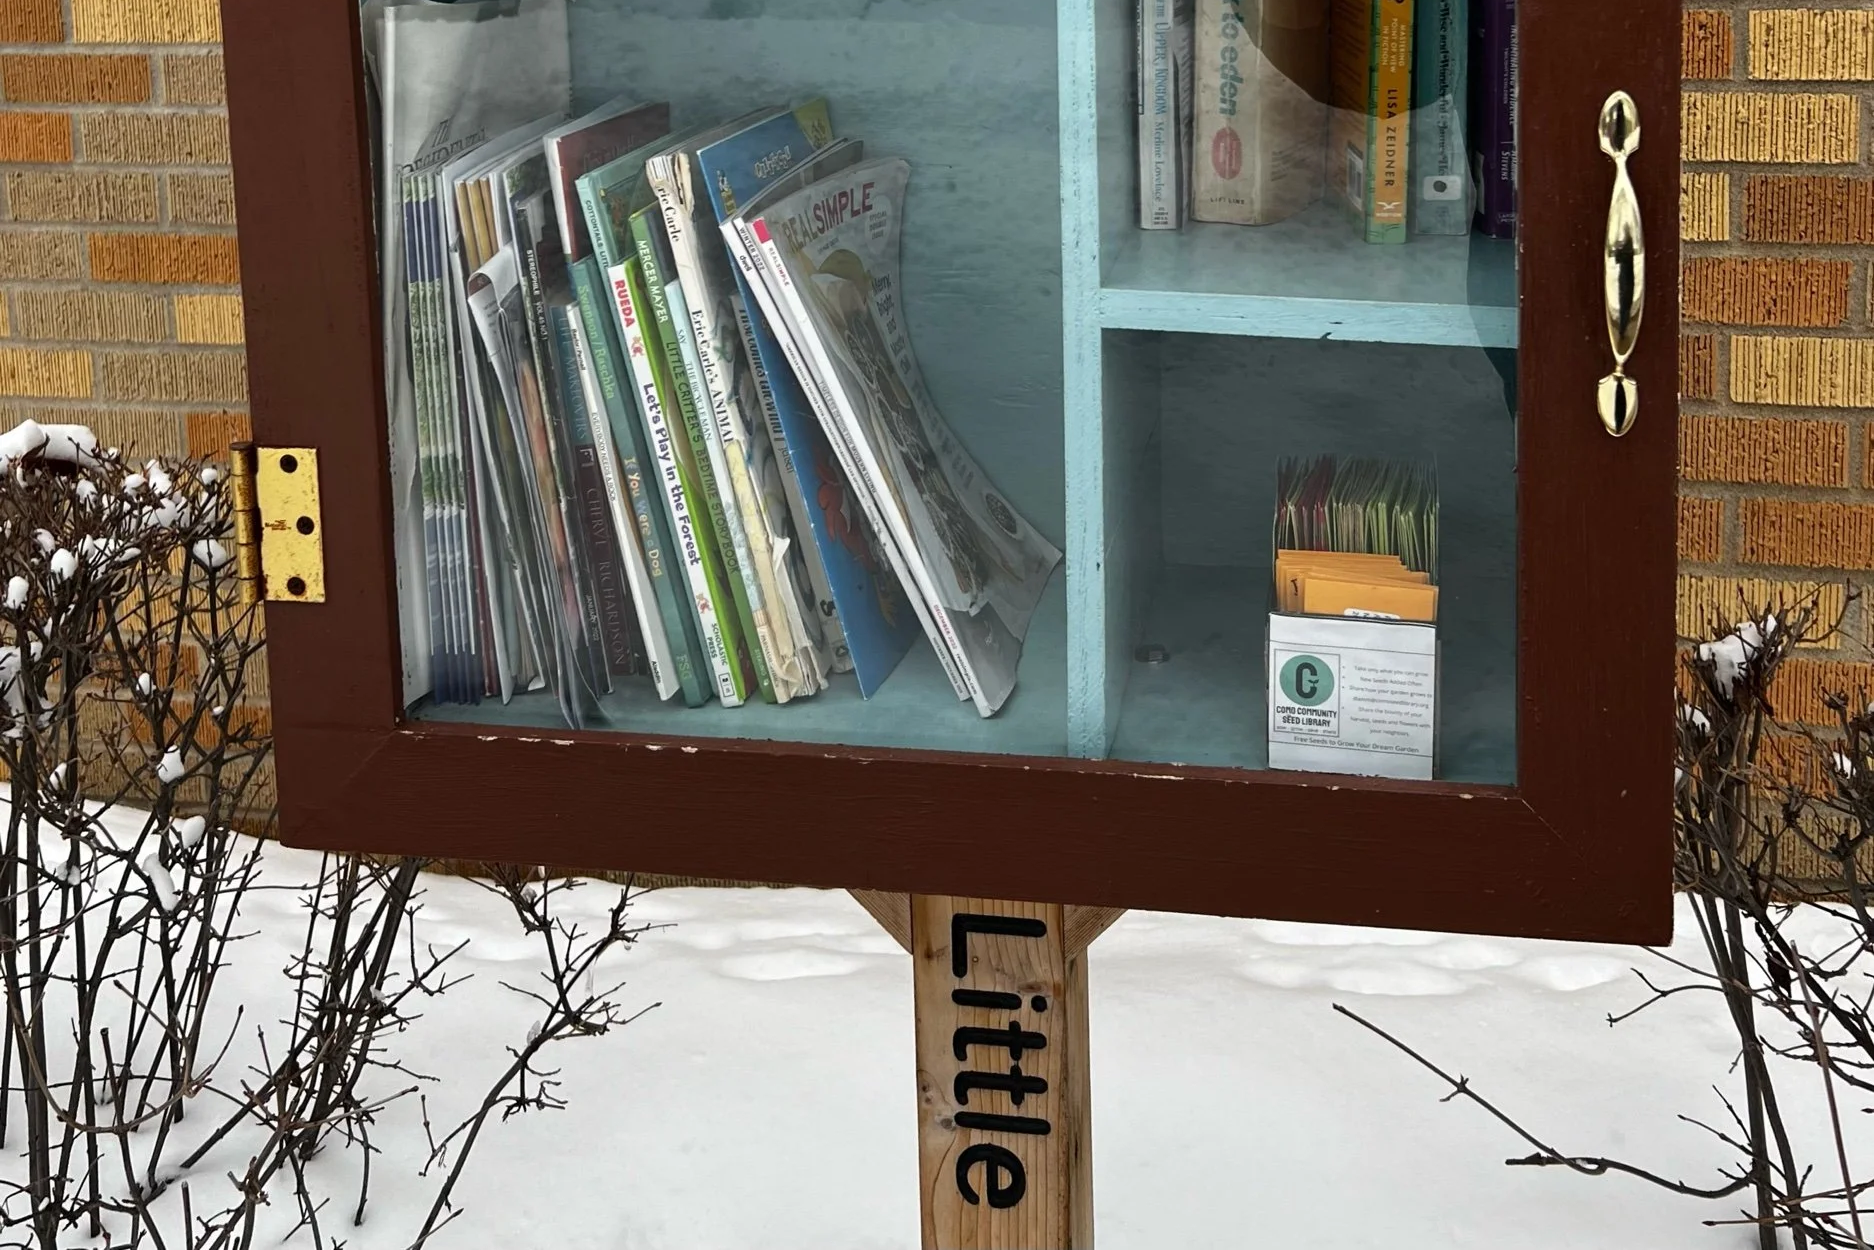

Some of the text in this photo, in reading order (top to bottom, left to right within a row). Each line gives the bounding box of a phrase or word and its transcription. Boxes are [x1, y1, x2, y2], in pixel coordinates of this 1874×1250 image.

[1221, 12, 1245, 40] to
[1382, 25, 1389, 33] IN
[1439, 3, 1452, 33] Wise
[1391, 41, 1397, 50] OF
[1398, 24, 1407, 67] MASTERING
[1440, 34, 1451, 54] and
[1153, 67, 1168, 115] KINGDOM
[1219, 45, 1244, 116] eden
[1384, 88, 1398, 188] LISA ZEIDNER
[1154, 160, 1167, 203] Lovelace
[1500, 150, 1511, 181] STEVENS
[585, 200, 604, 248] COTTONTAILS
[657, 187, 681, 242] ric Carle
[739, 255, 752, 272] dwell
[740, 228, 766, 271] WINTER 2022
[526, 249, 541, 296] STEREOPHILE
[637, 240, 669, 324] MERCER MAYER
[614, 279, 635, 328] RUEDA
[691, 309, 706, 338] Eric
[578, 284, 599, 339] Swenson
[594, 348, 615, 400] Raschka
[698, 339, 718, 385] Carle's
[566, 357, 587, 440] MAKEOVERS
[677, 329, 688, 344] SAY
[700, 418, 713, 441] MAN
[624, 456, 640, 471] If
[643, 382, 701, 567] Let's Play in the Forest
[666, 341, 739, 573] LITTLE CRITTER'S BEDTIME STORYBOOK
[628, 472, 641, 498] You
[636, 500, 652, 536] Were
[586, 487, 626, 664] CHERYL RICHARDSON
[648, 549, 663, 577] Dog
[933, 604, 952, 635] DECEMBER
[707, 636, 718, 659] PRESS
[711, 623, 728, 666] SCHOLASTIC
[676, 654, 692, 680] FSG
[1276, 705, 1338, 719] COMO COMMUNITY
[1282, 715, 1331, 727] SEED LIBRARY
[1294, 735, 1420, 753] Free Seeds to Grow Your Dream Garden
[951, 912, 1052, 1210] Little
